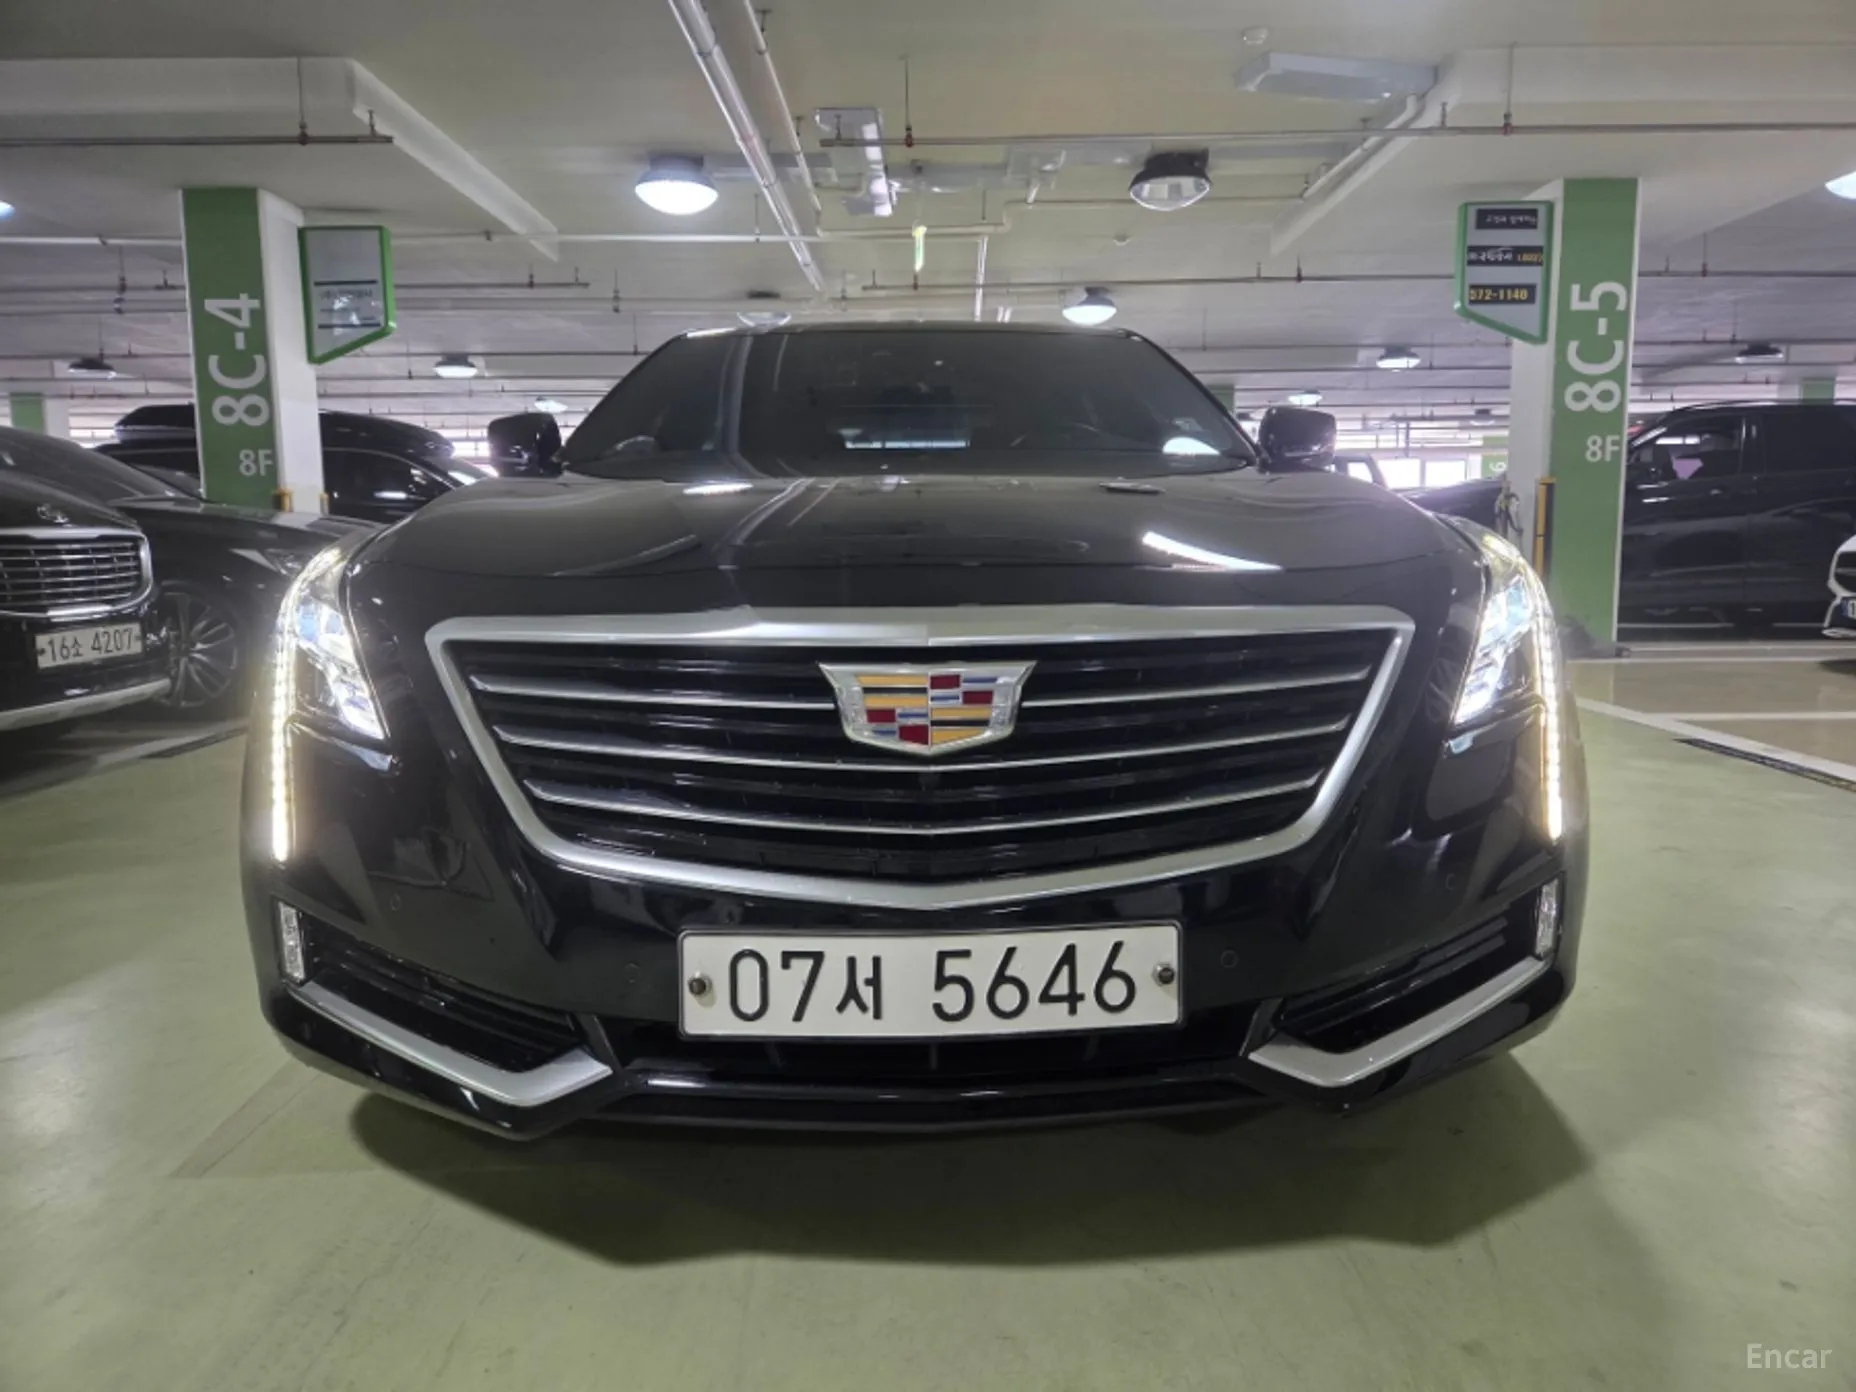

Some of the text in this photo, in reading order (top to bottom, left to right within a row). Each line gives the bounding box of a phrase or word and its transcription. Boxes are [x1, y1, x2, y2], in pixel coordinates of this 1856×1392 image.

[204, 293, 270, 426] 8C-4
[1564, 281, 1628, 413] 8C-5
[239, 449, 274, 477] 8F
[1585, 435, 1621, 463] 8F
[48, 628, 133, 663] 16소 4207
[729, 941, 1136, 1022] 07서 5646
